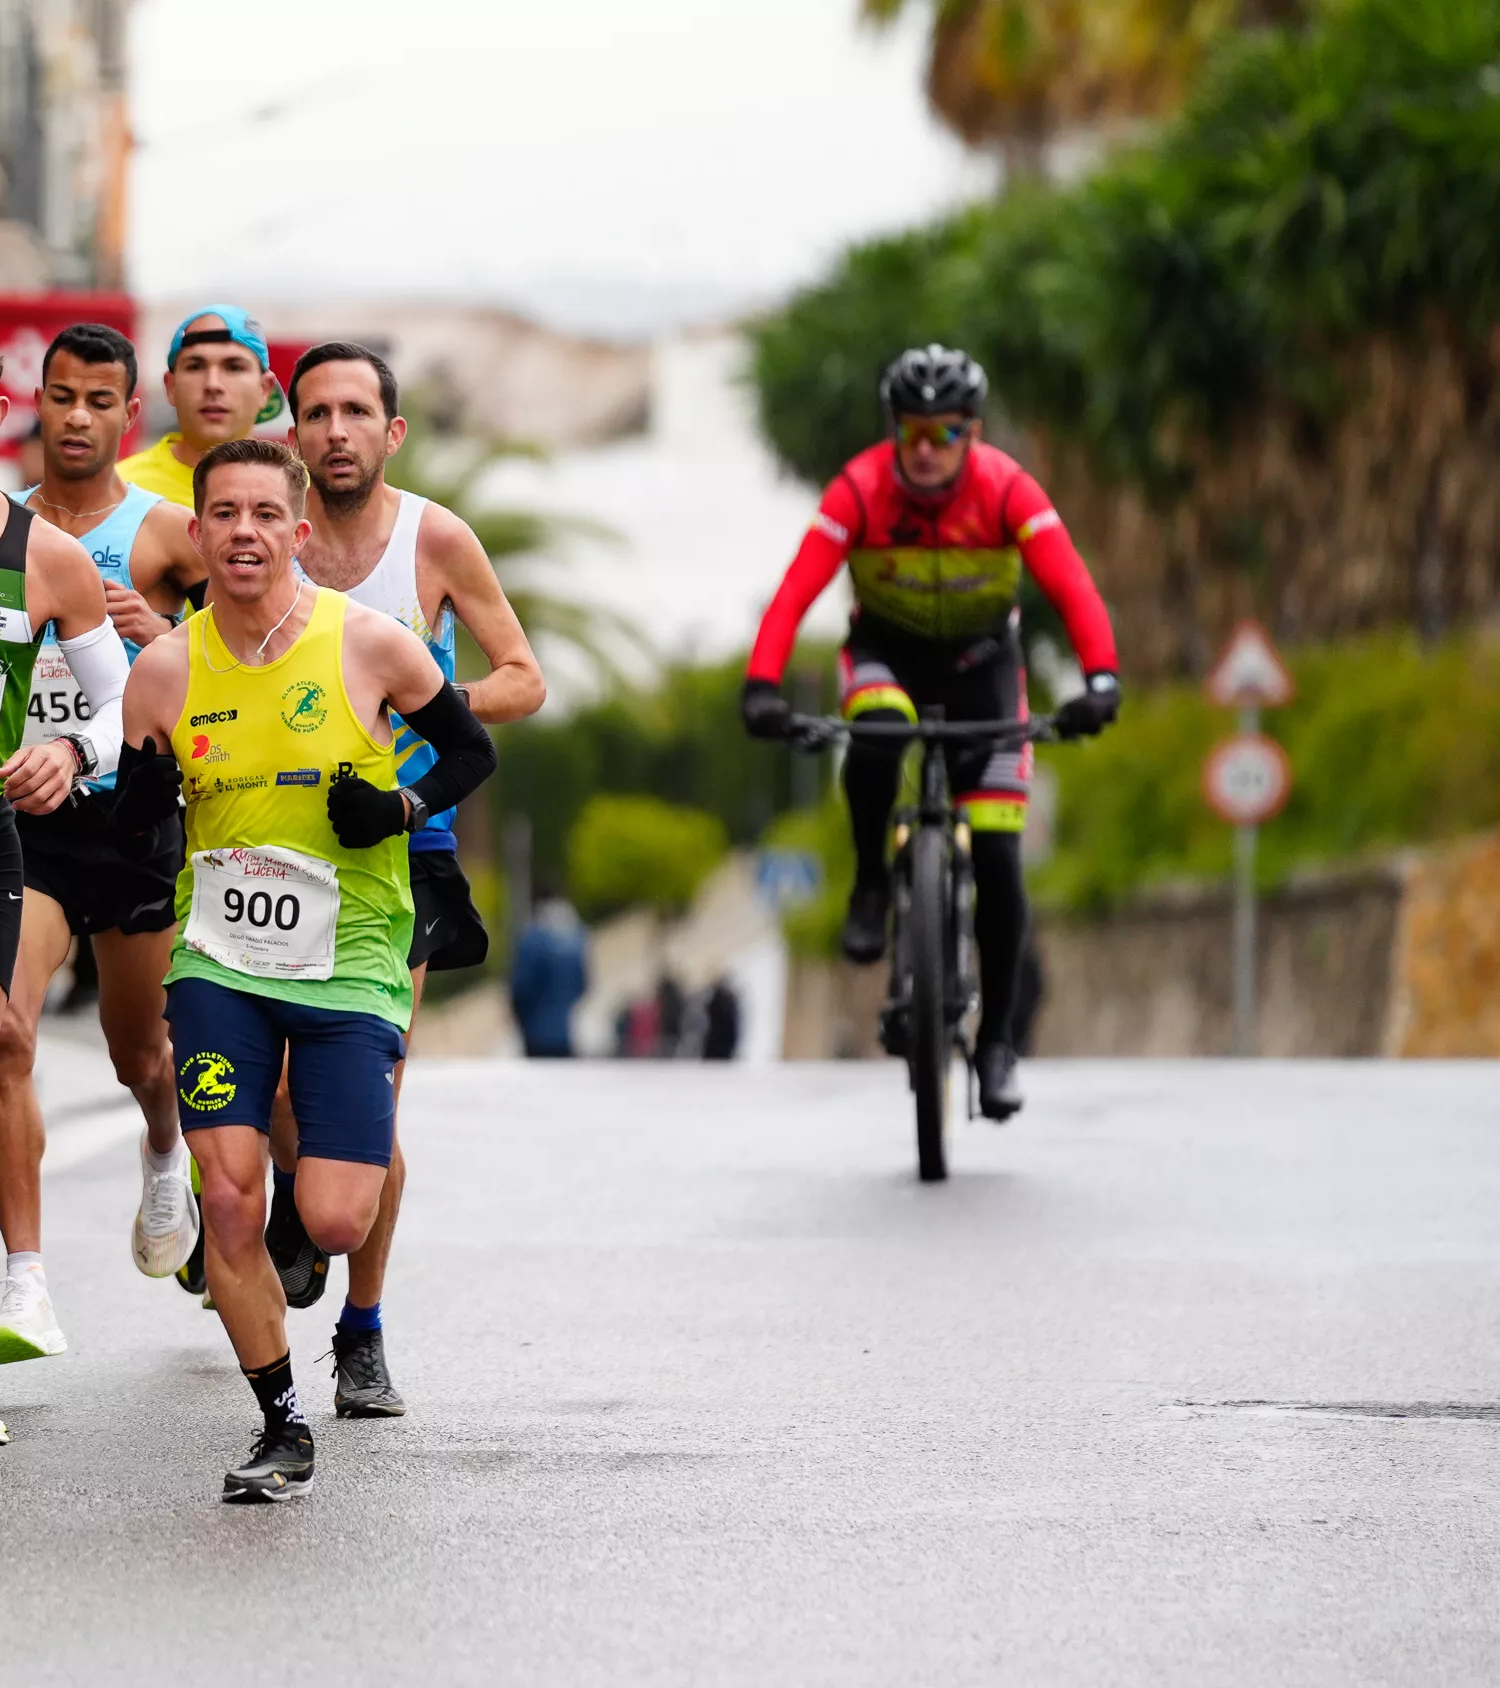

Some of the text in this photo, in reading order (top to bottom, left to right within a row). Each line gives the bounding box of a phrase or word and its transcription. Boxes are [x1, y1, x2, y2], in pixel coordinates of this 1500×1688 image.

[92, 545, 121, 567] als
[41, 667, 74, 679] LUCEN
[296, 681, 326, 698] ATLETISMO
[28, 690, 91, 723] 456
[190, 711, 227, 727] emec
[204, 750, 231, 765] Smith
[210, 744, 222, 756] DS
[225, 780, 269, 792] EL MONTE
[228, 774, 265, 784] BODEGAS
[244, 863, 293, 879] LUCENA
[224, 888, 300, 930] 900
[229, 932, 289, 947] DIEGO TIRADO PALACIOS
[180, 1052, 235, 1076] CLUB ATLETISMO
[179, 1088, 206, 1112] RUNNERS
[207, 1099, 228, 1112] PURA
